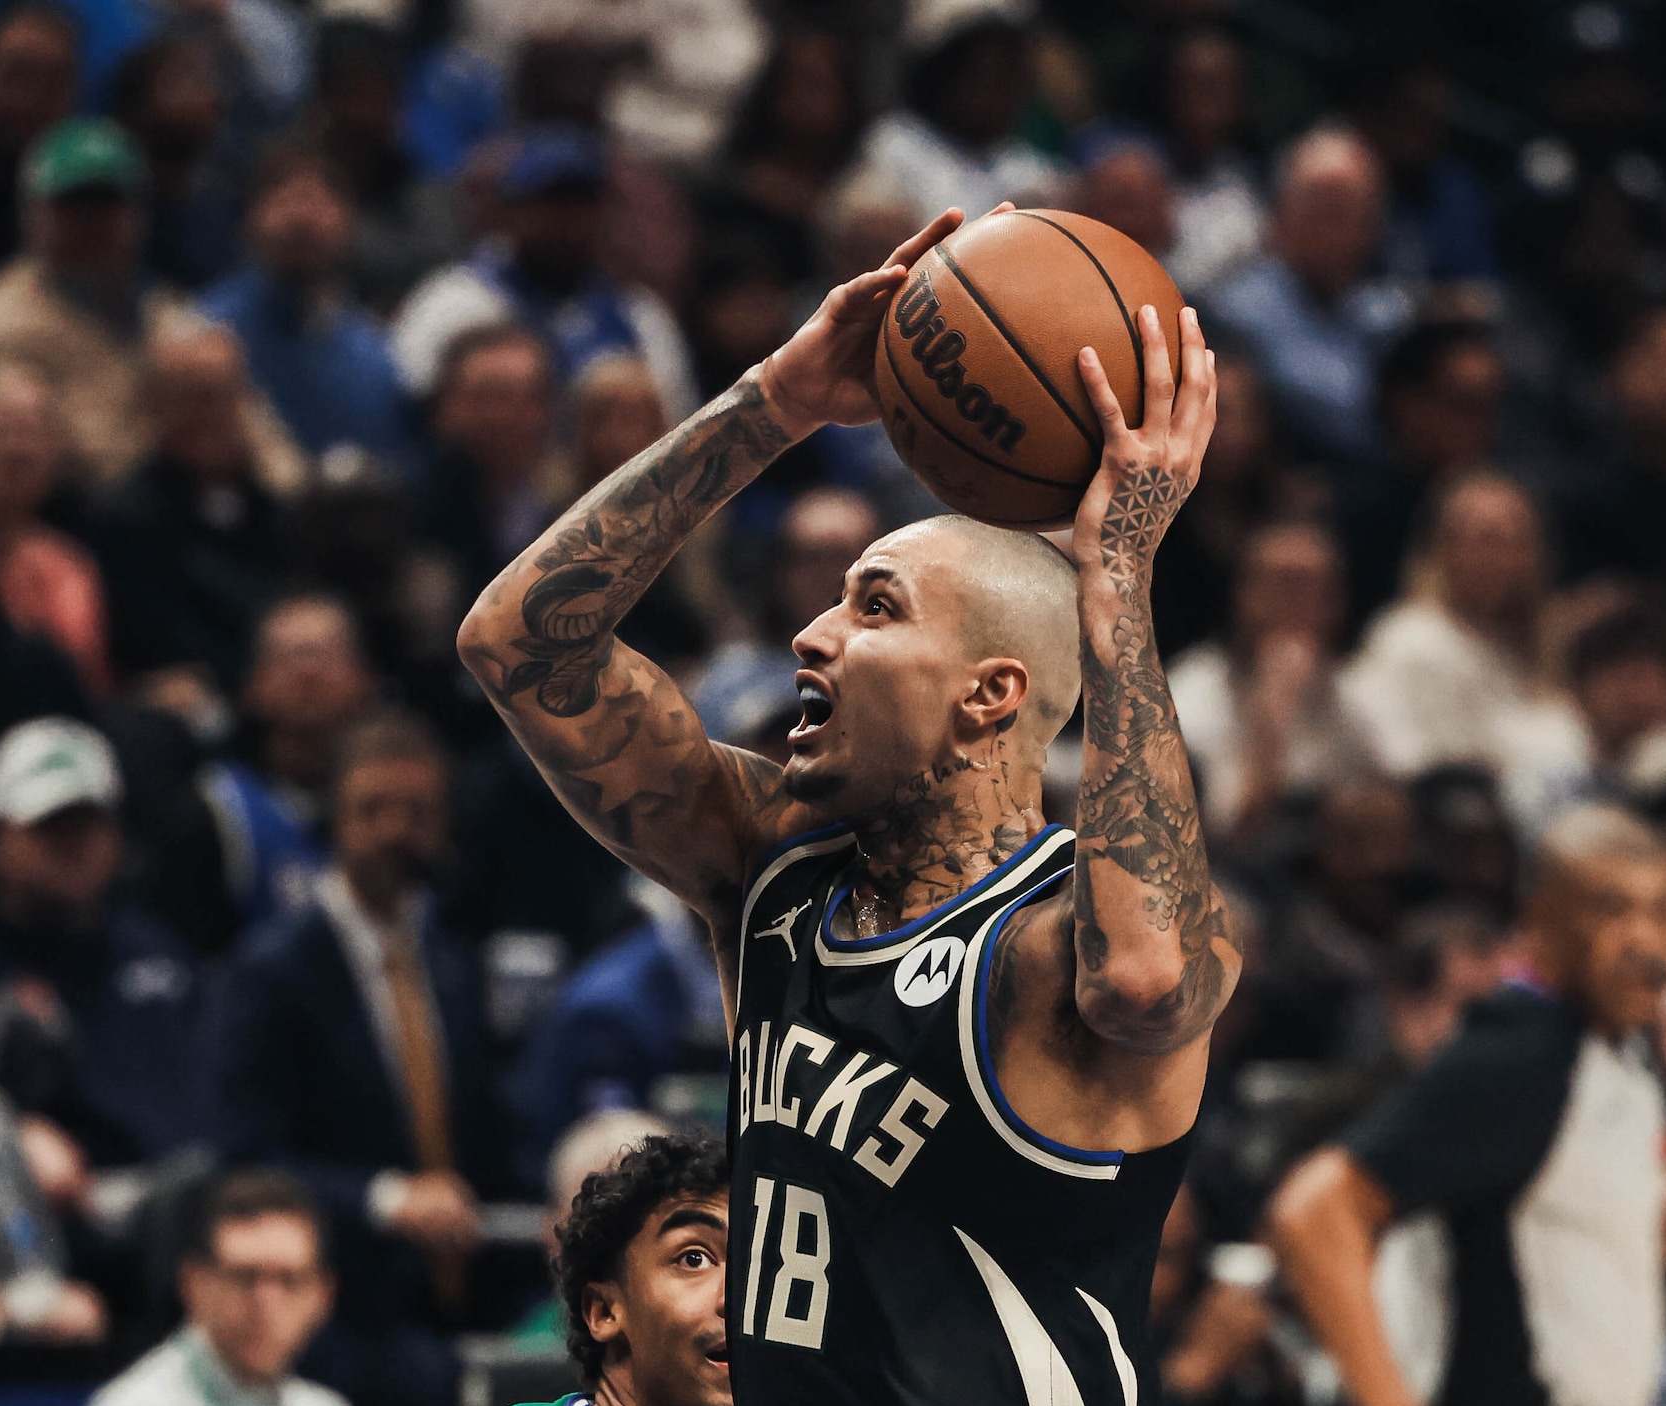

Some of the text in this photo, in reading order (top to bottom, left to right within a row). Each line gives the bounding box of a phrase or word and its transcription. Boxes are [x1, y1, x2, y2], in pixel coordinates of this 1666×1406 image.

[895, 268, 1026, 455] Wilson
[738, 1020, 951, 1189] BUCKS
[741, 1176, 831, 1351] 18
